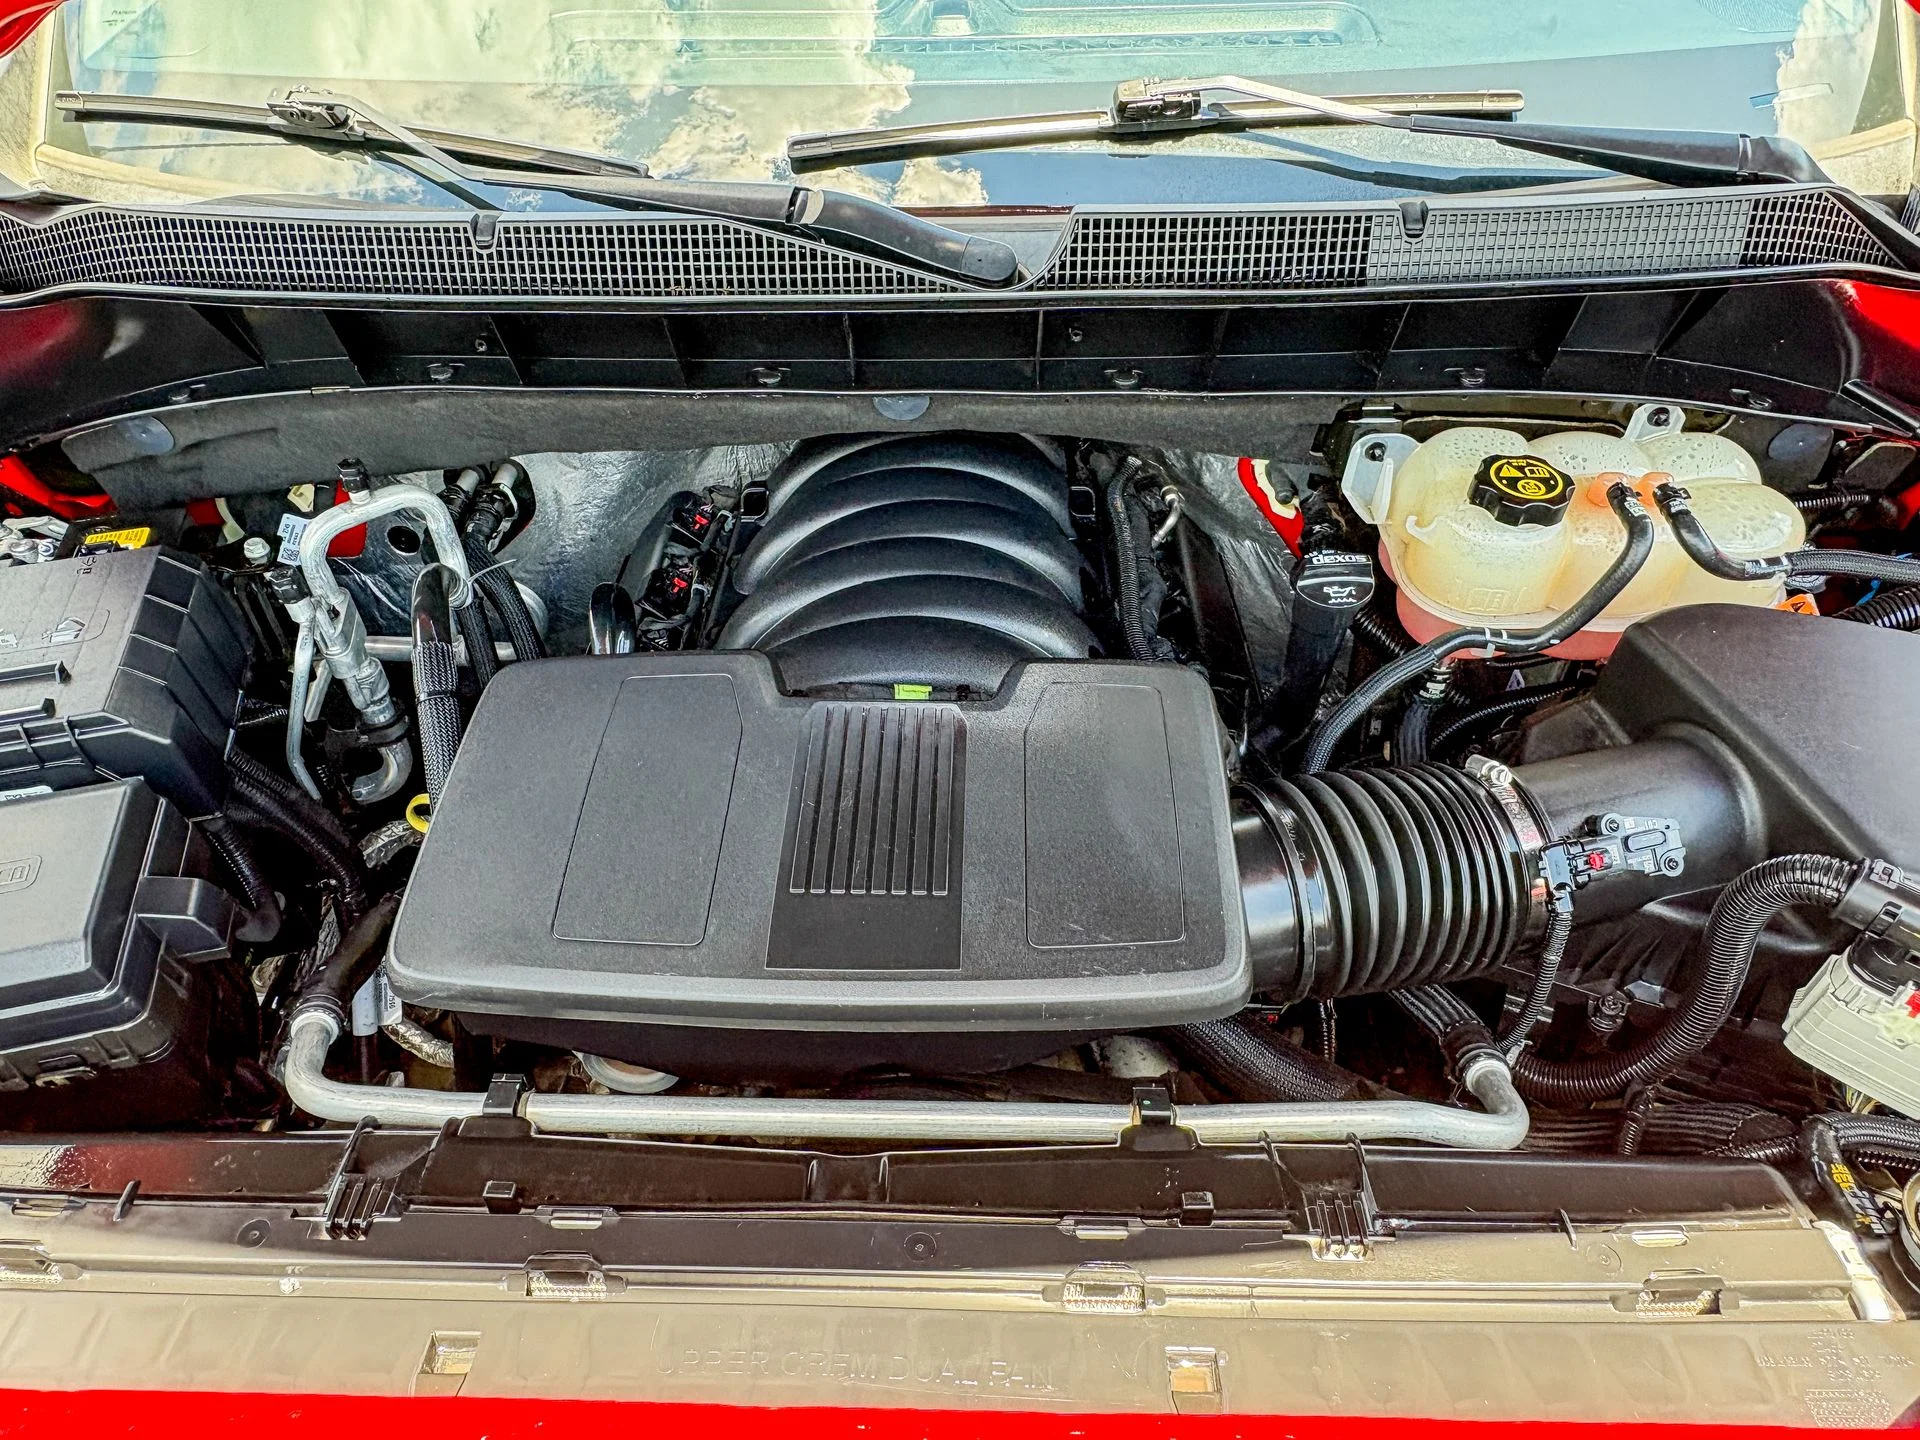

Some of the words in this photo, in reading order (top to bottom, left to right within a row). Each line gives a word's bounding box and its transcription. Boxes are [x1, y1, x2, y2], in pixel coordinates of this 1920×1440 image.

[1312, 554, 1368, 565] dexos
[655, 1349, 769, 1375] UPPER
[888, 1356, 978, 1386] DUAL
